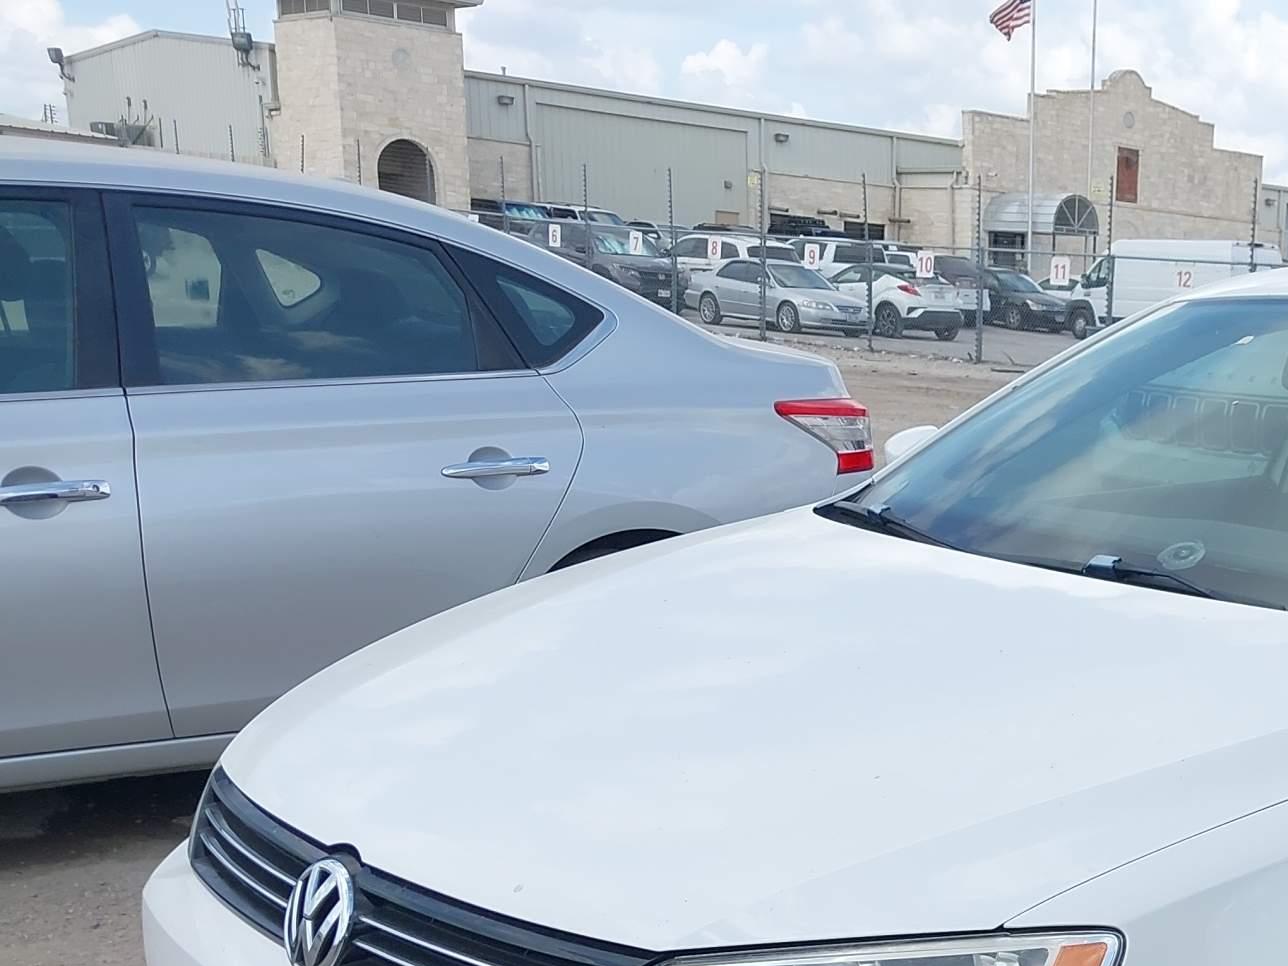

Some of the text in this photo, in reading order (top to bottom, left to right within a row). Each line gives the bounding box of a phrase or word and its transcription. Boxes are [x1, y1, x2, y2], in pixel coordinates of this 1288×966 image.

[550, 229, 558, 242] 6
[632, 236, 640, 250] 7
[710, 240, 719, 255] 8
[808, 249, 817, 265] 9
[918, 256, 934, 273] 10
[1053, 263, 1067, 280] 11
[1176, 271, 1193, 288] 12
